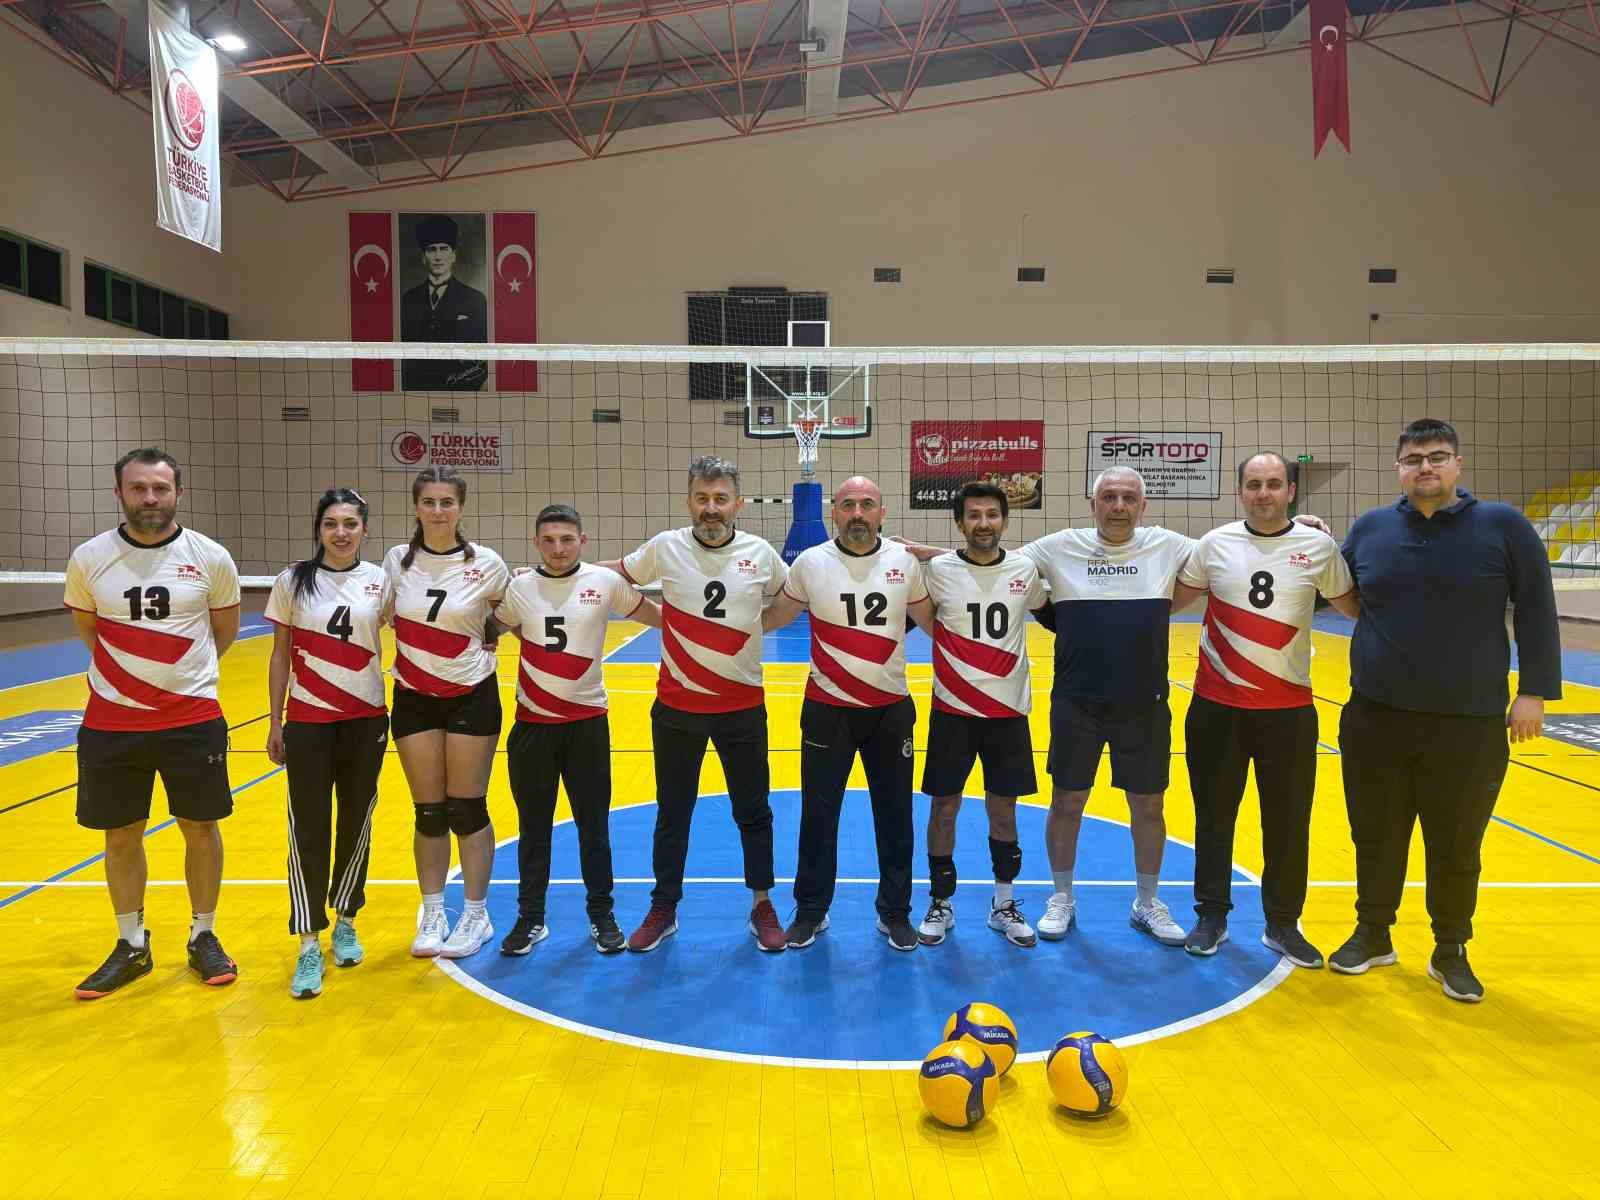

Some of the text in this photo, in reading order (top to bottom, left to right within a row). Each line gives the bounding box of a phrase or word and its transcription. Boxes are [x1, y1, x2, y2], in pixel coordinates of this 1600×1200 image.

[431, 431, 500, 448] TÜRKİYE
[431, 448, 499, 458] BASKETBOL
[951, 436, 1039, 453] pizzabulls
[431, 458, 499, 466] FEDERASYONU
[917, 490, 934, 500] 444
[937, 490, 948, 500] 32
[1088, 566, 1138, 575] MADRID
[124, 586, 170, 621] 13
[426, 589, 447, 622] 7
[703, 580, 726, 618] 2
[1248, 570, 1274, 609] 8
[326, 605, 353, 642] 4
[840, 592, 888, 627] 12
[966, 602, 1009, 640] 10
[544, 616, 568, 653] 5
